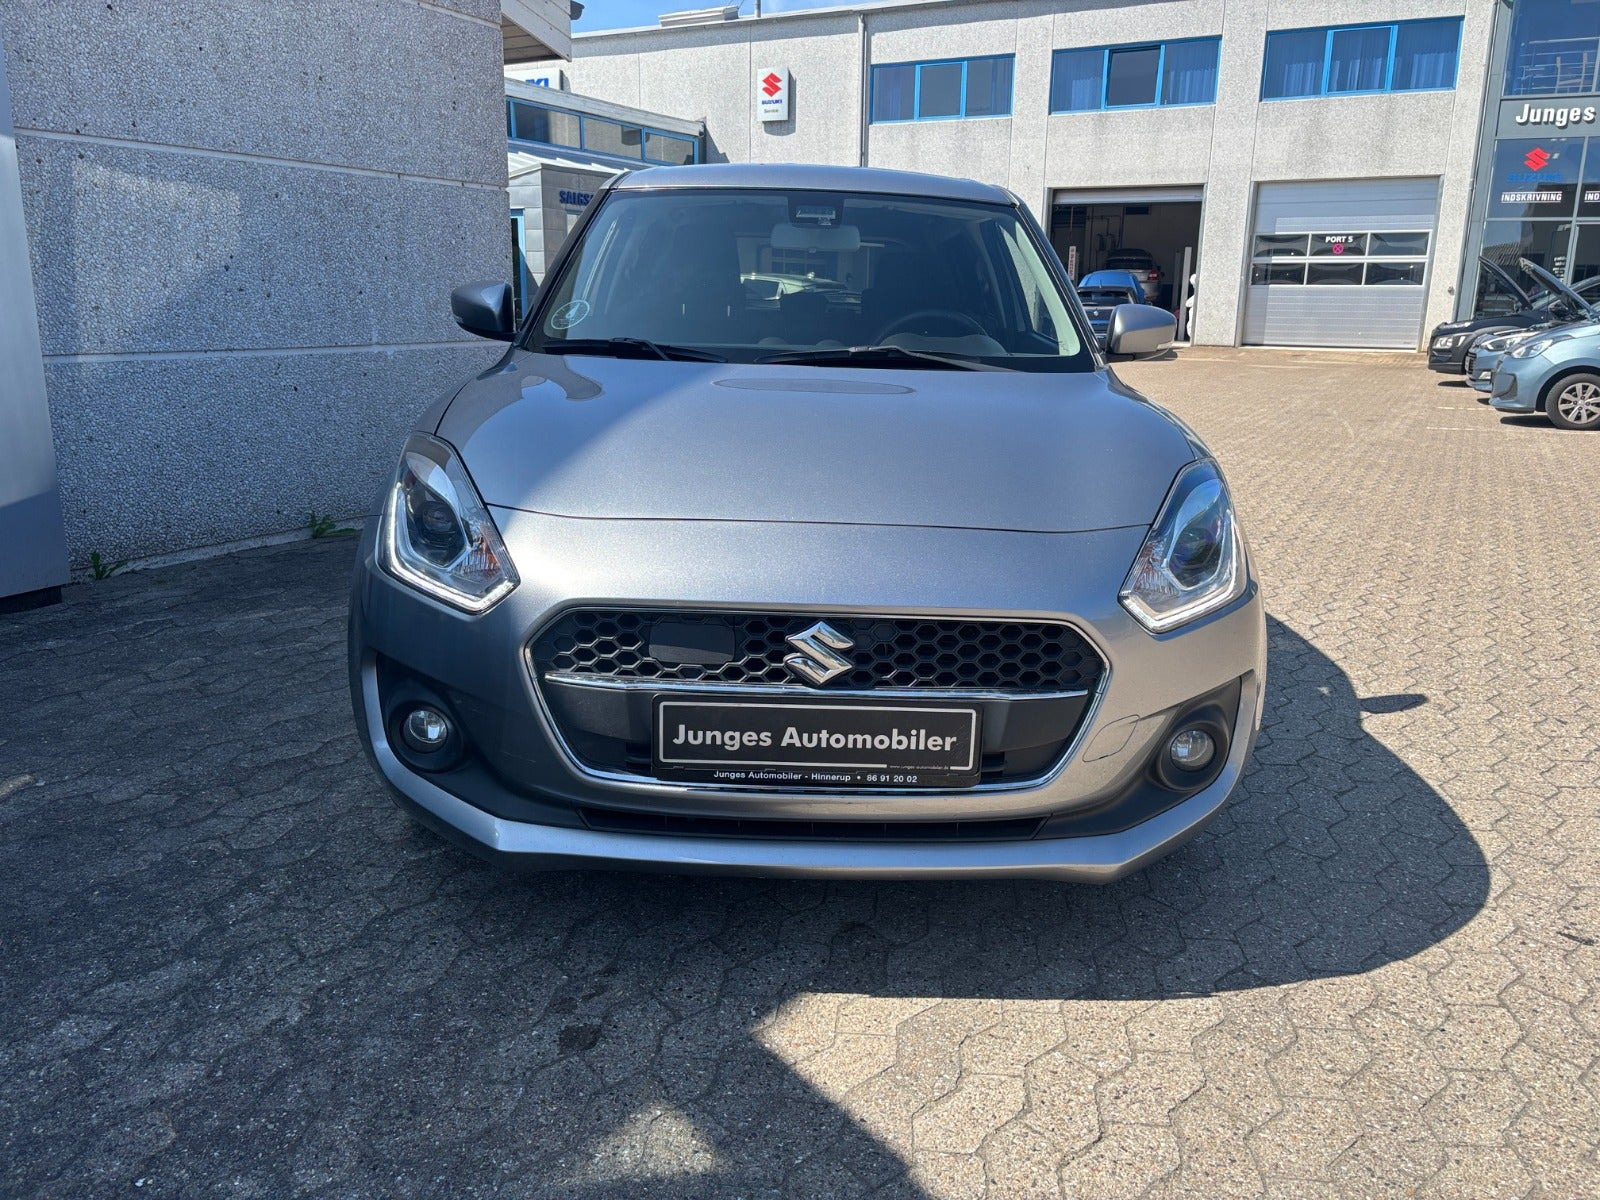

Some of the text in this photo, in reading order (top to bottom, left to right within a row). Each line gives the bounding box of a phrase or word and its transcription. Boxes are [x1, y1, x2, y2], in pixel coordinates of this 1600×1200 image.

[1515, 103, 1596, 127] Junges
[559, 190, 593, 206] SALGS
[1501, 193, 1562, 201] INDSKRIVNING
[672, 724, 957, 751] Junges Automobiler
[714, 770, 746, 779] Junges
[748, 771, 802, 779] Automobiler
[811, 773, 851, 781] Hinnerup
[867, 774, 877, 782] 86
[893, 775, 904, 783] 20
[906, 775, 918, 783] 02
